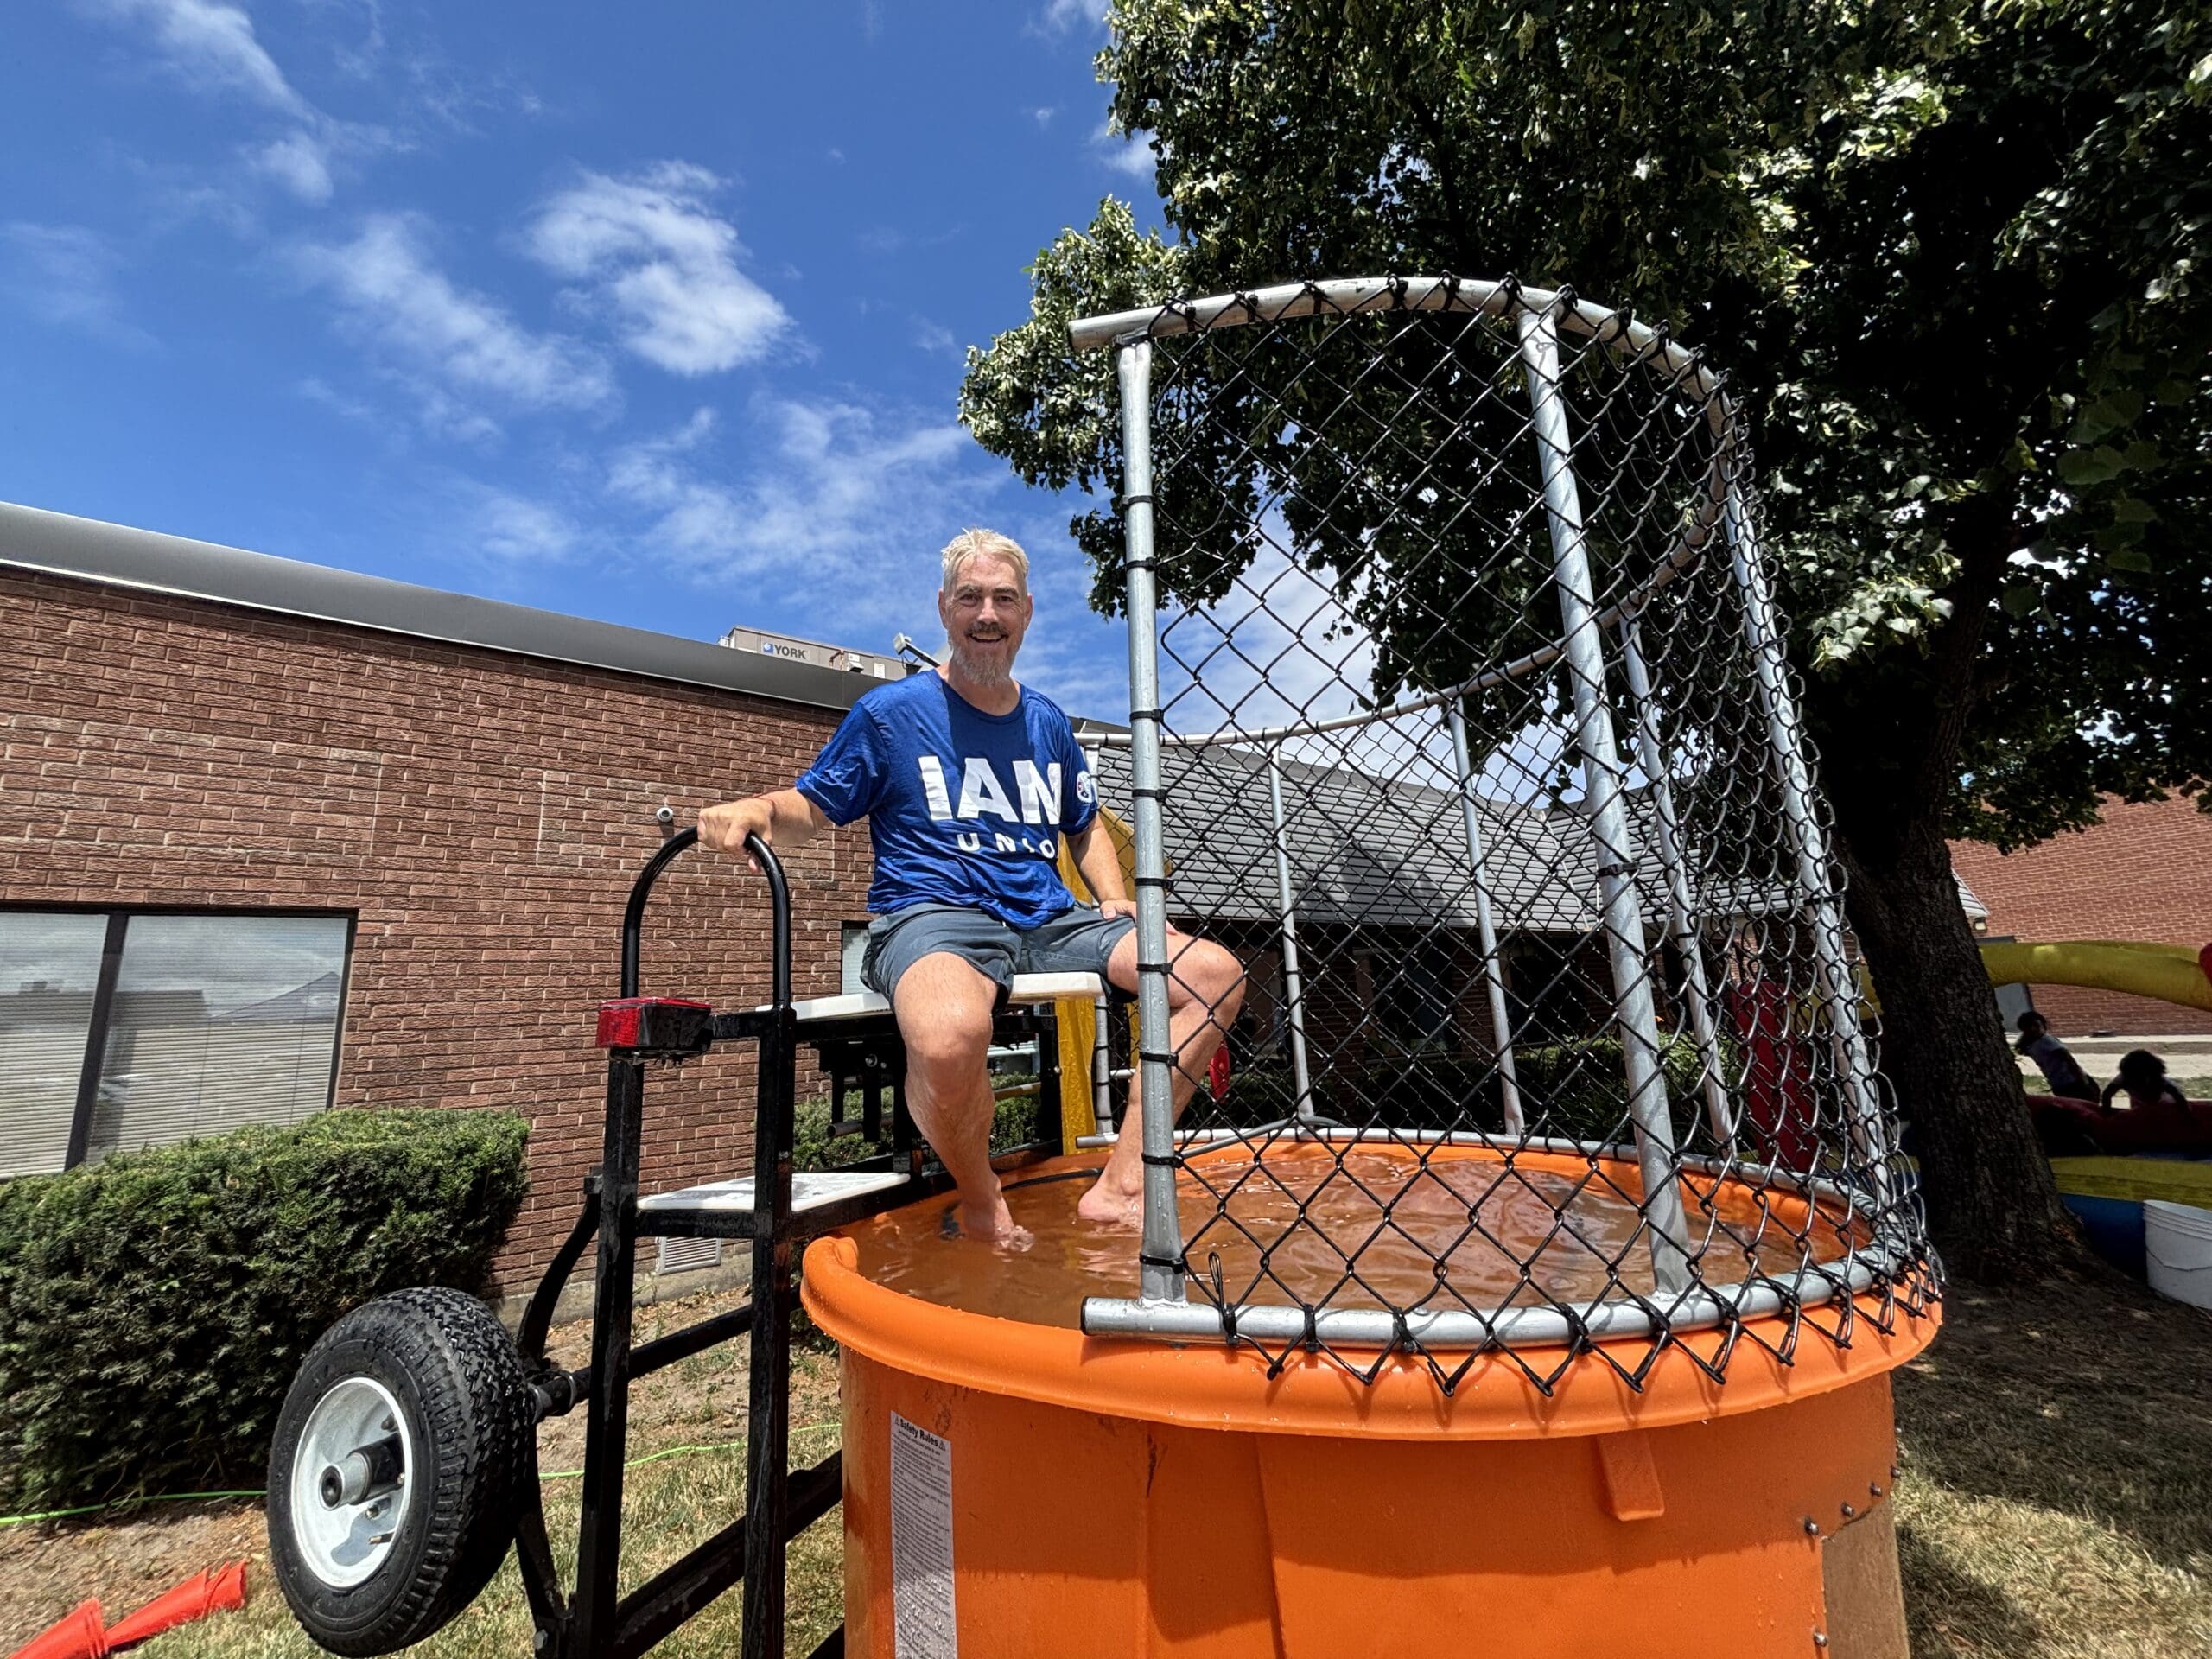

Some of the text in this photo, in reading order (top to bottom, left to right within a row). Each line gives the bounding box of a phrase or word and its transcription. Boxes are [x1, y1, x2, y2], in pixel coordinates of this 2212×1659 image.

[774, 644, 806, 660] YORK
[900, 1418, 938, 1446] Safety Rules
